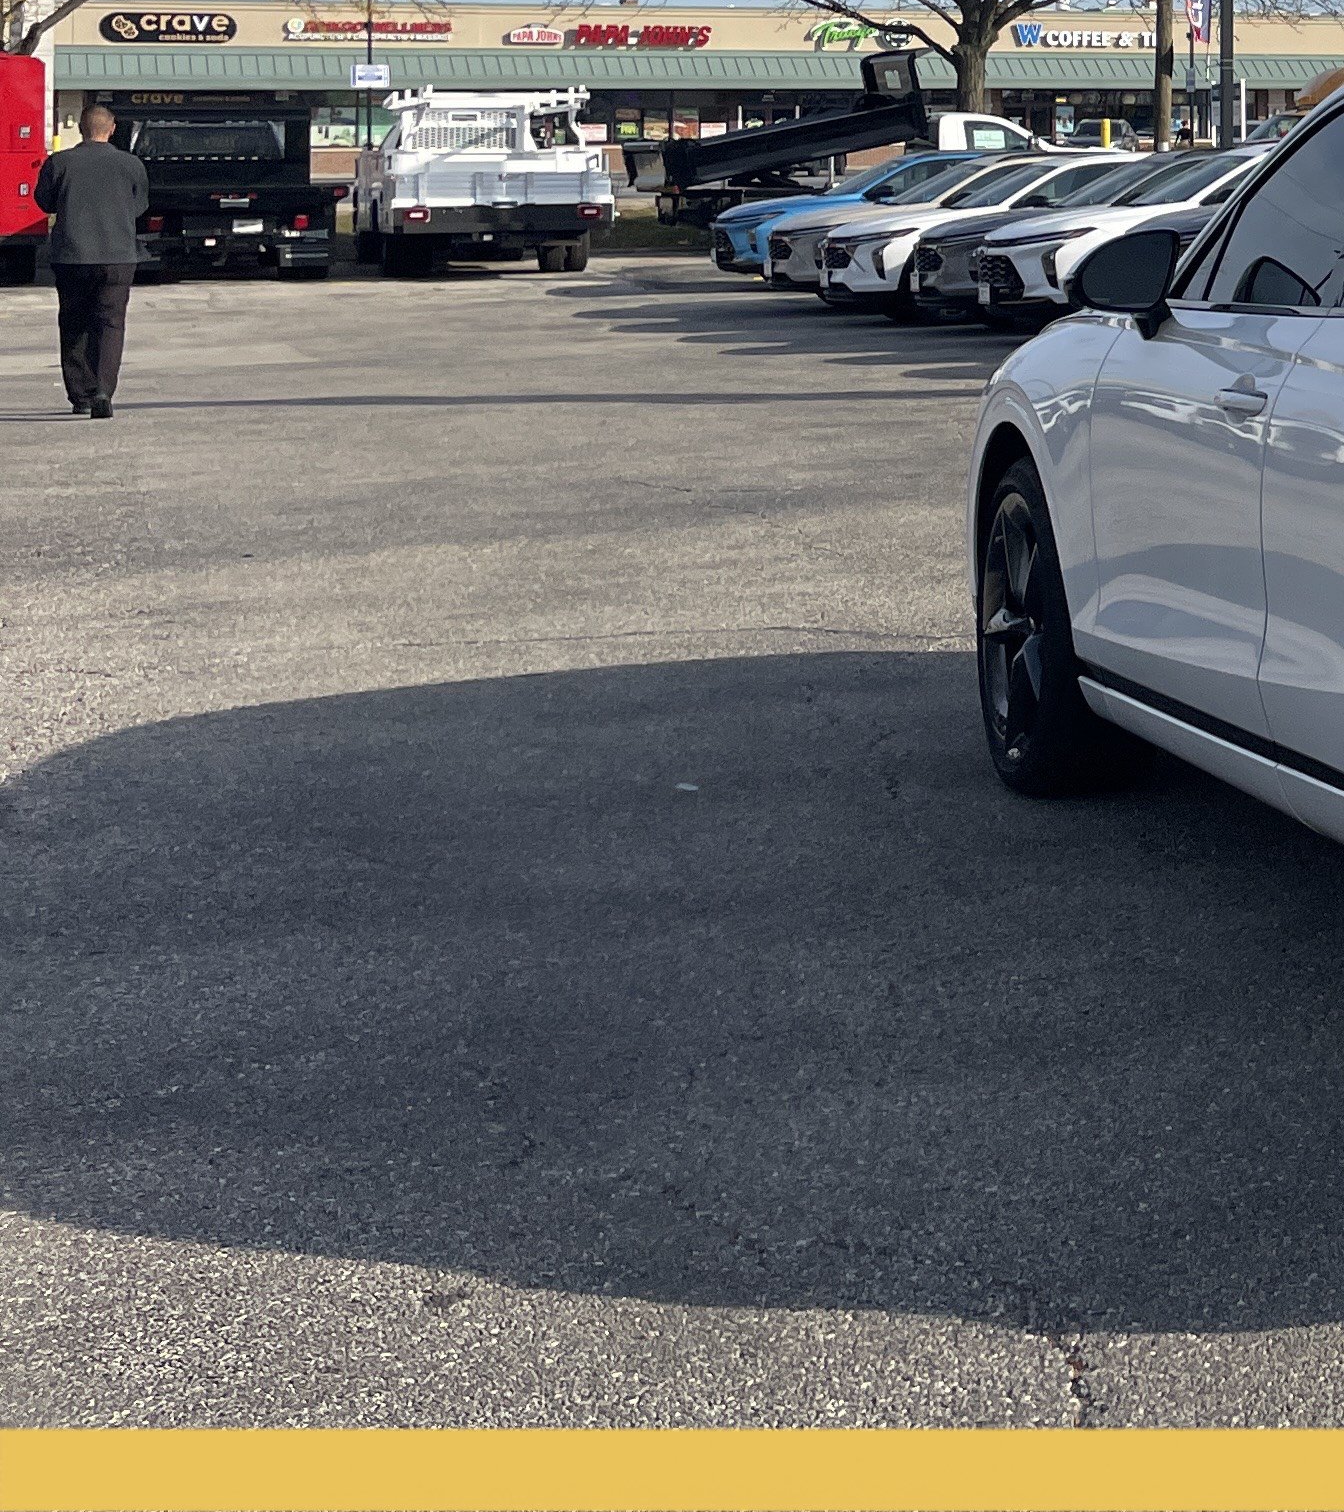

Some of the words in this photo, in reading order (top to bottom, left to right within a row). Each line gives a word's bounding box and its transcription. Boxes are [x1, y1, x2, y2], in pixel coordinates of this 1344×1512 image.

[139, 14, 230, 32] crave
[512, 29, 534, 43] PAPA
[575, 24, 631, 47] PAPA
[638, 25, 712, 48] JOHN'S
[1017, 23, 1042, 46] W
[1046, 30, 1112, 47] COFFEE
[1118, 31, 1134, 47] &
[131, 93, 184, 105] crave
